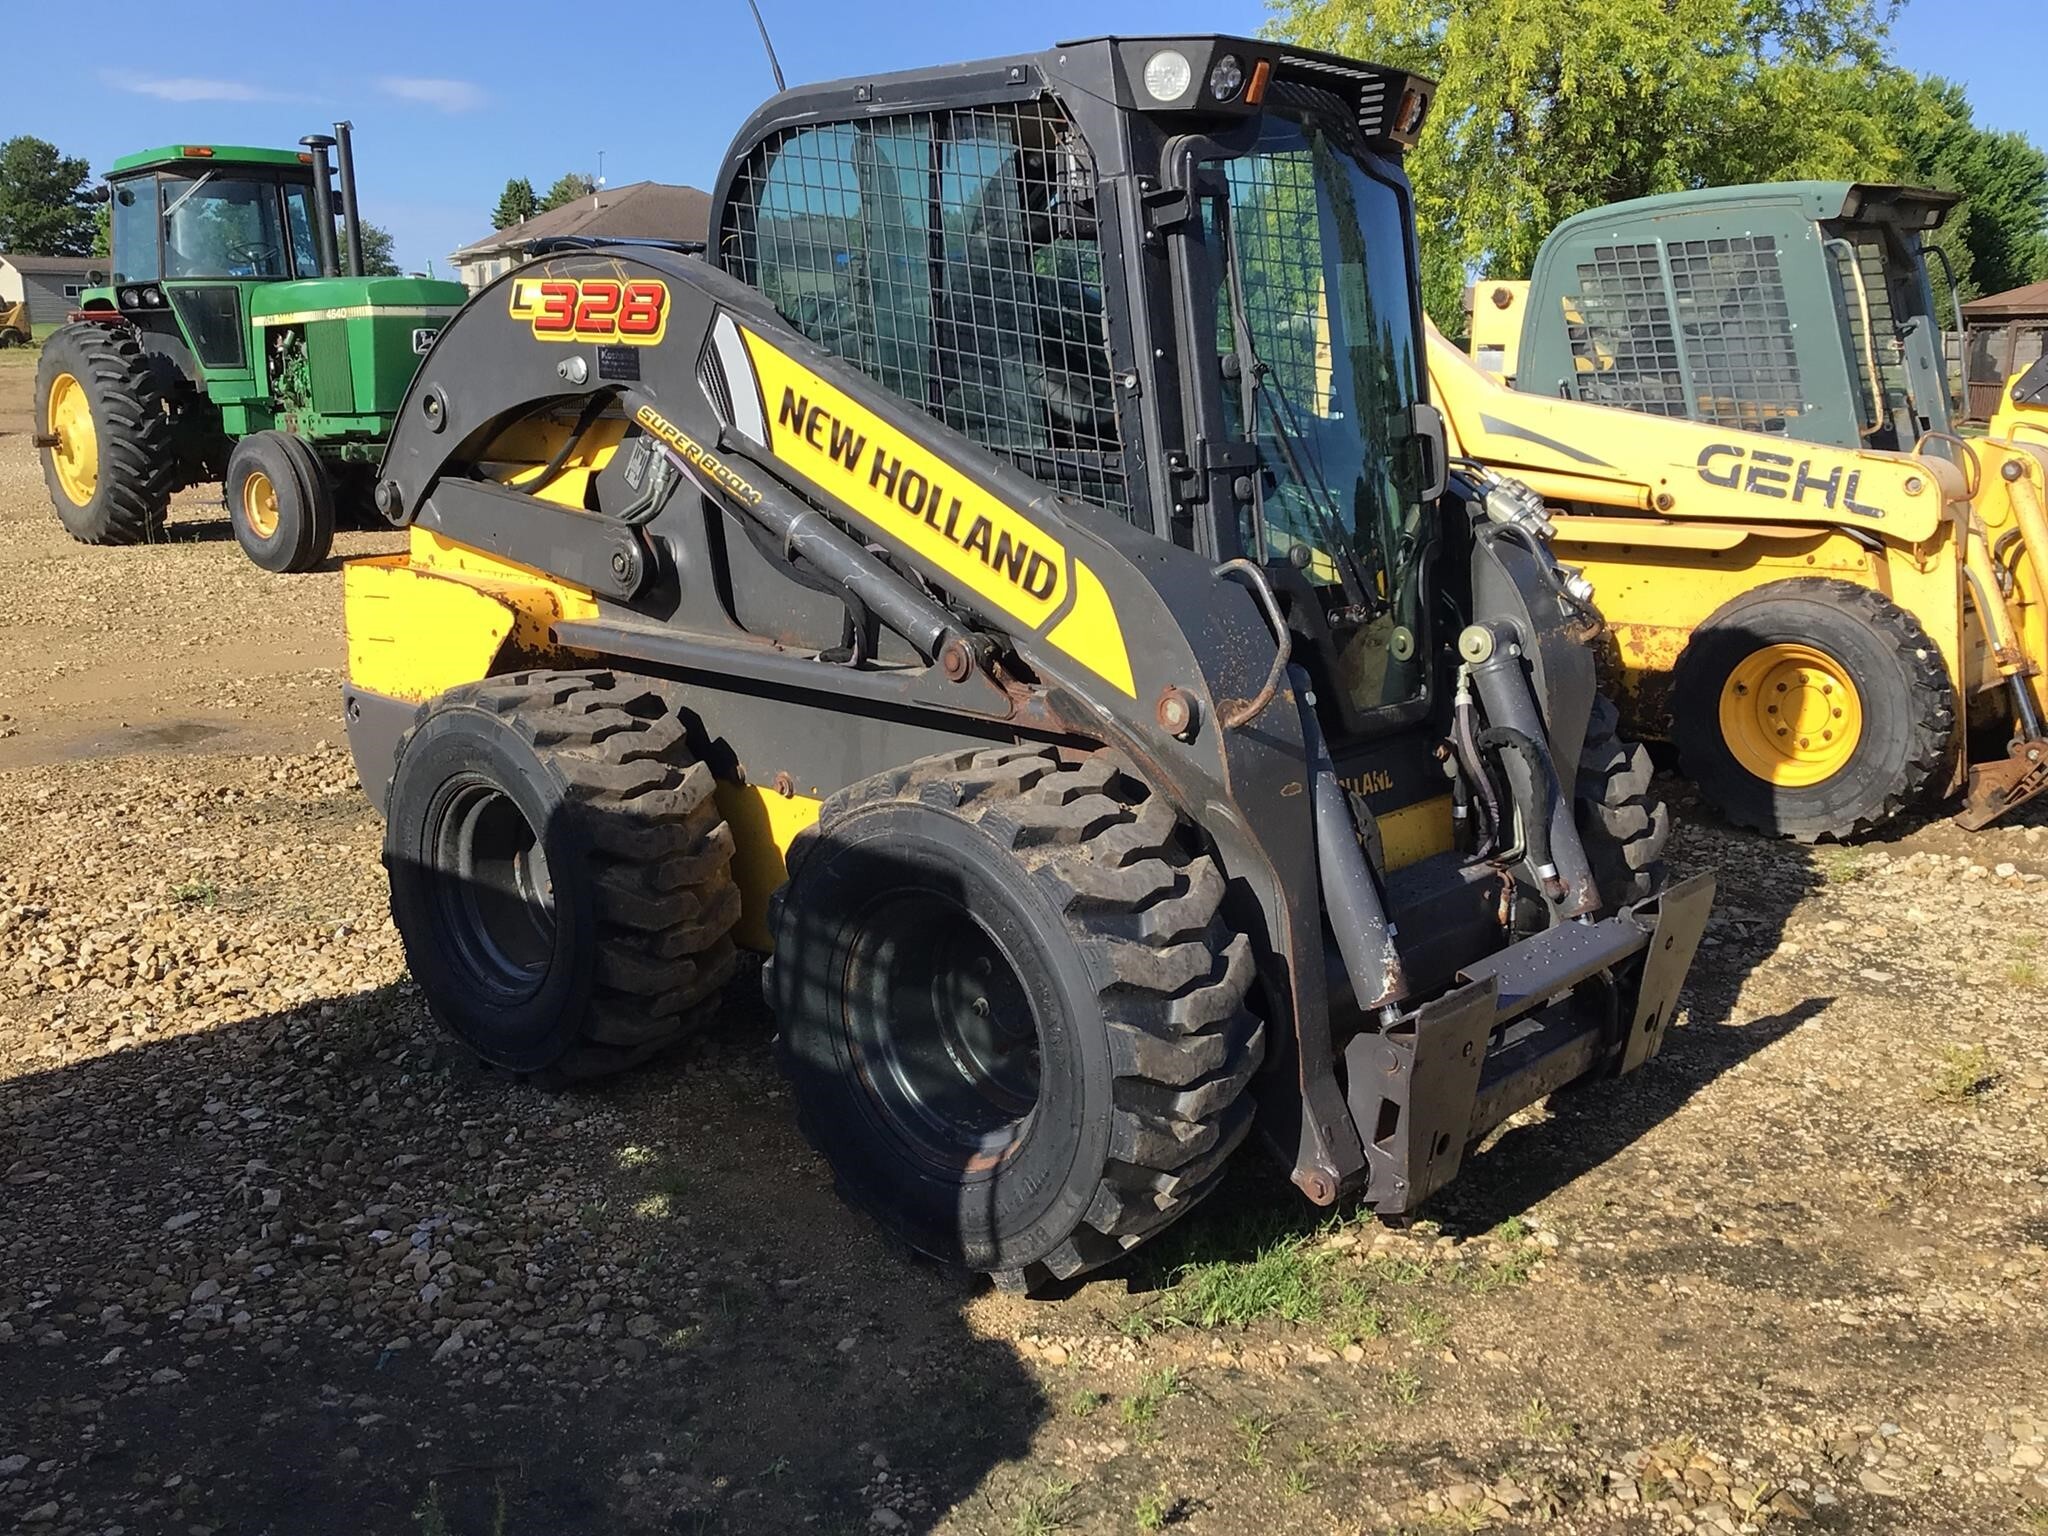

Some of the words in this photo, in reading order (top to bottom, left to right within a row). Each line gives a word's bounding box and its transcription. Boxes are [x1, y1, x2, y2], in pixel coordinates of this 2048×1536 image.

[778, 386, 866, 471] NEW
[868, 447, 1058, 602] HOLLAND
[1697, 443, 1886, 519] GEHL
